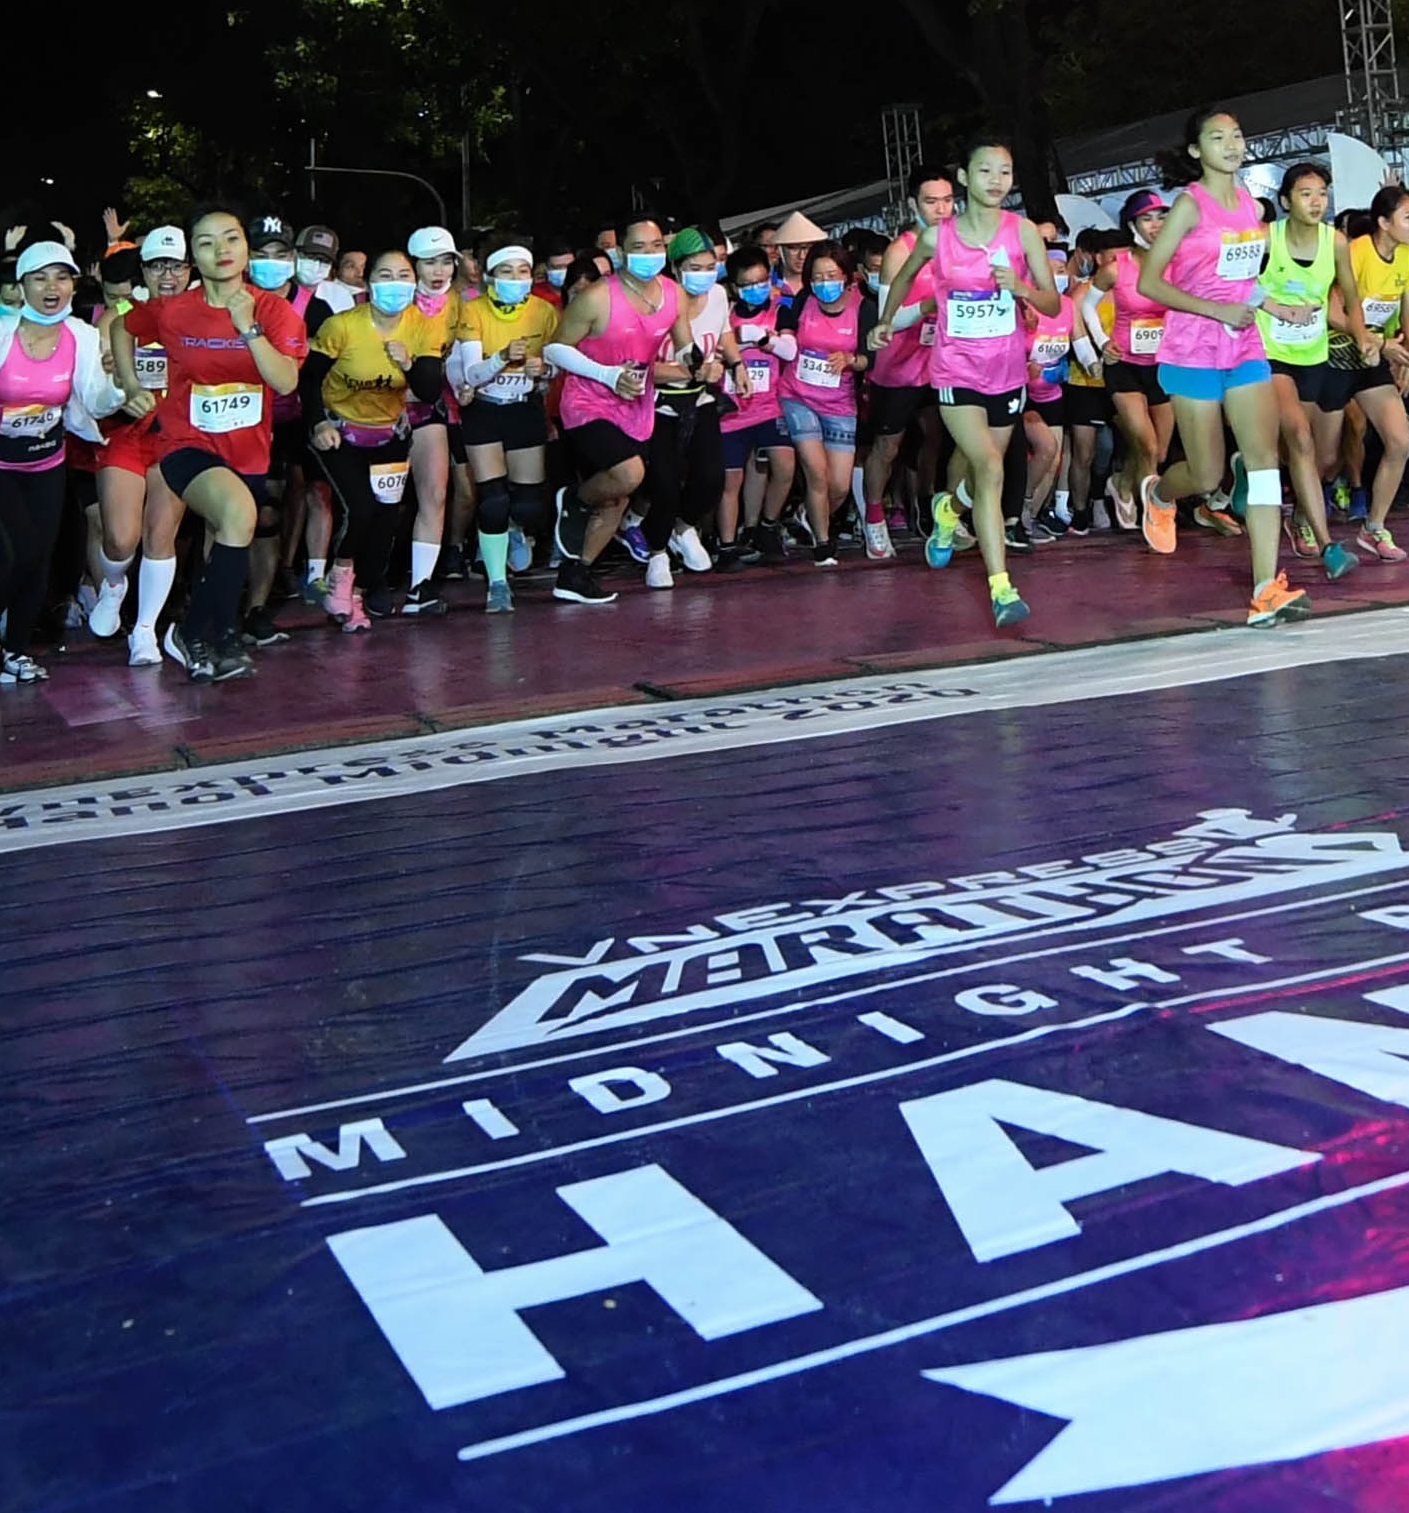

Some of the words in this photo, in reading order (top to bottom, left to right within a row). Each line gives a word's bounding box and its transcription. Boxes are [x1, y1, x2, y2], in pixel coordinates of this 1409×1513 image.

[1135, 329, 1164, 341] 6909
[201, 395, 251, 415] 61749
[377, 475, 407, 490] 6076
[780, 686, 983, 722] 2020
[264, 938, 1272, 1182] MIDNIGHT
